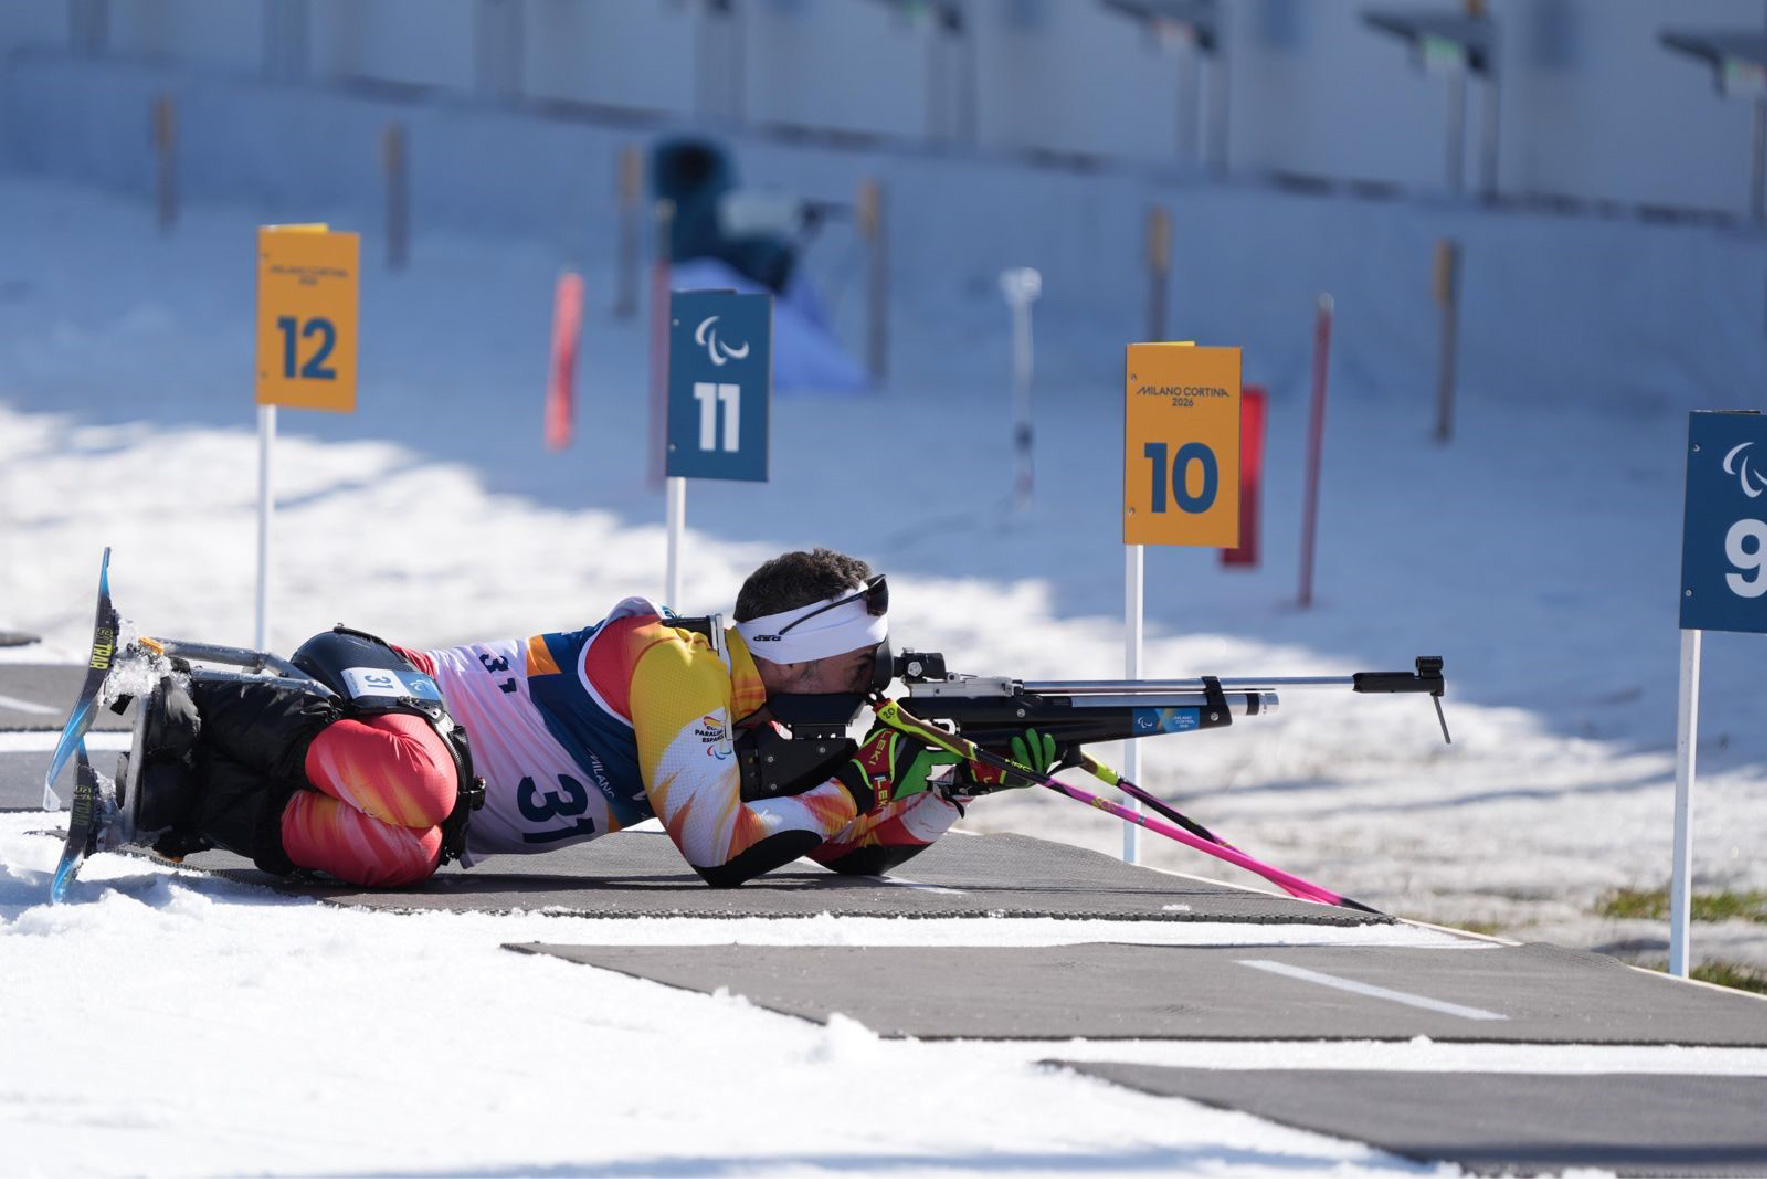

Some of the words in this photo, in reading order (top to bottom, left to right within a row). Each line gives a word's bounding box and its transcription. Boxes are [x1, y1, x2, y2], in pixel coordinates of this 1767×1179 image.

[277, 316, 337, 381] 12
[694, 382, 741, 453] 11
[1136, 386, 1182, 396] MILANO
[1183, 387, 1230, 398] CORTINA
[1172, 397, 1194, 407] 2026
[1144, 442, 1218, 514] 10
[1725, 518, 1767, 598] 9
[364, 675, 395, 689] 31
[868, 730, 893, 767] LEKI
[517, 773, 595, 844] 31
